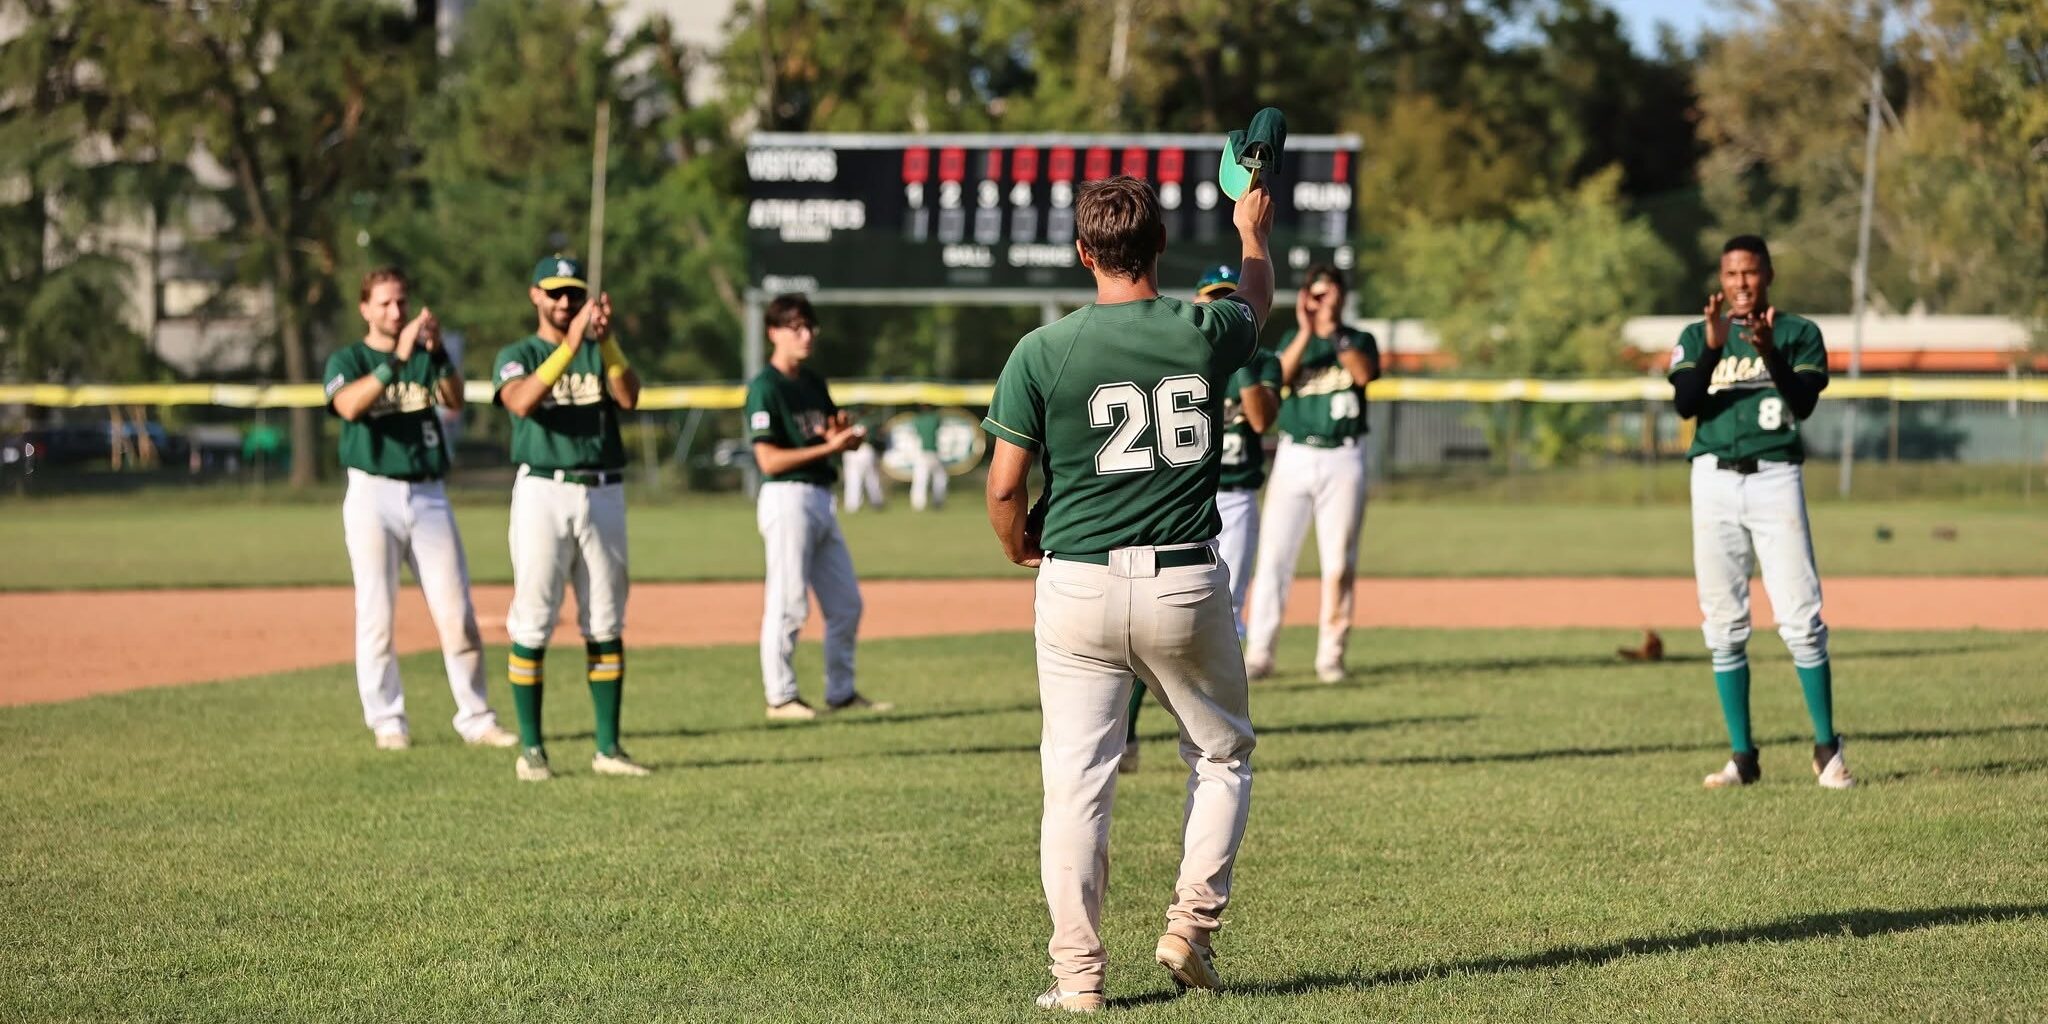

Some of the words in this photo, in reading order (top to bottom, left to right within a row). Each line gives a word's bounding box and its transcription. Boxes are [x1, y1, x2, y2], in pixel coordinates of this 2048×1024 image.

[747, 149, 837, 182] VISITORS
[905, 181, 923, 208] 1
[940, 181, 961, 209] 2
[977, 181, 998, 209] 3
[1010, 181, 1031, 208] 4
[1196, 181, 1218, 210] 9
[1294, 181, 1351, 211] RUN
[748, 199, 865, 230] ATHLETICS
[942, 244, 994, 267] BALL
[1087, 374, 1211, 476] 26
